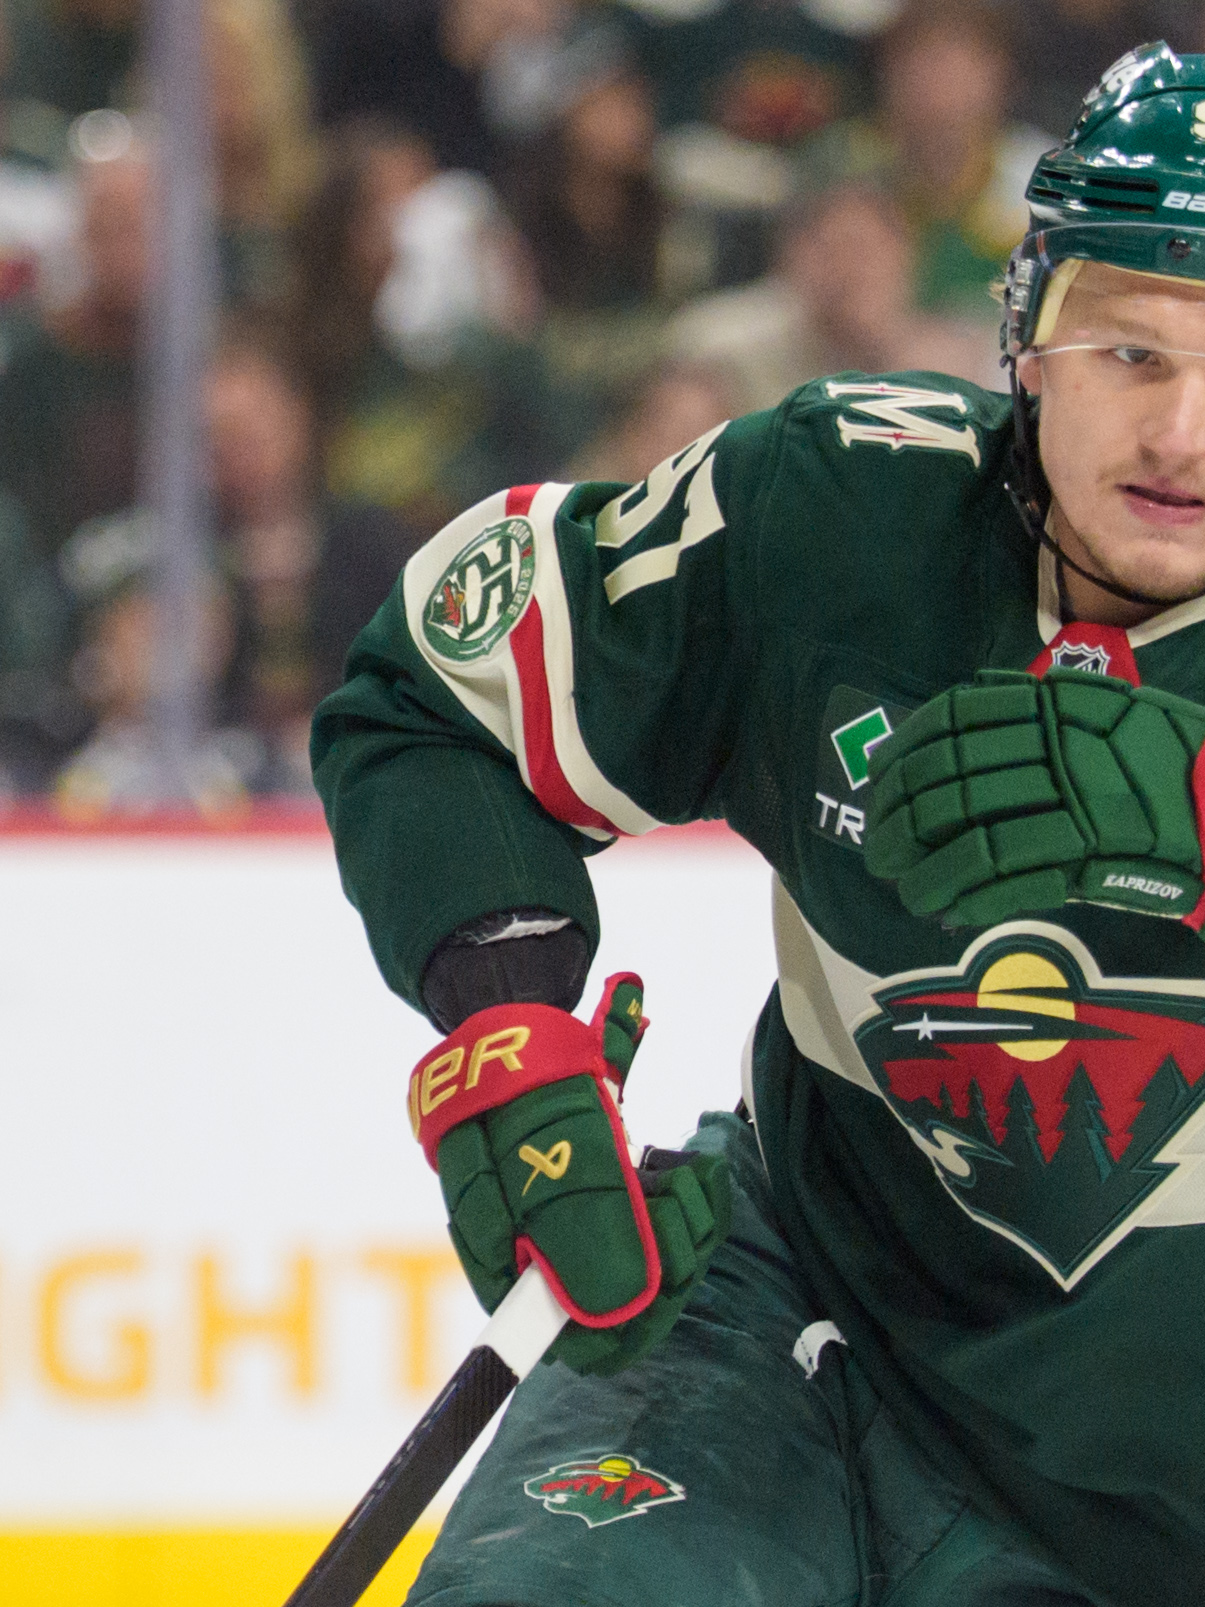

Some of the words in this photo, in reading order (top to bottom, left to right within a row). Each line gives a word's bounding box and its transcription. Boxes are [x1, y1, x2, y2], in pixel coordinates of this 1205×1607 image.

[825, 381, 982, 469] M
[814, 792, 867, 846] TR
[1102, 873, 1184, 900] KAPRIZOV
[0, 1248, 464, 1400] GHT
